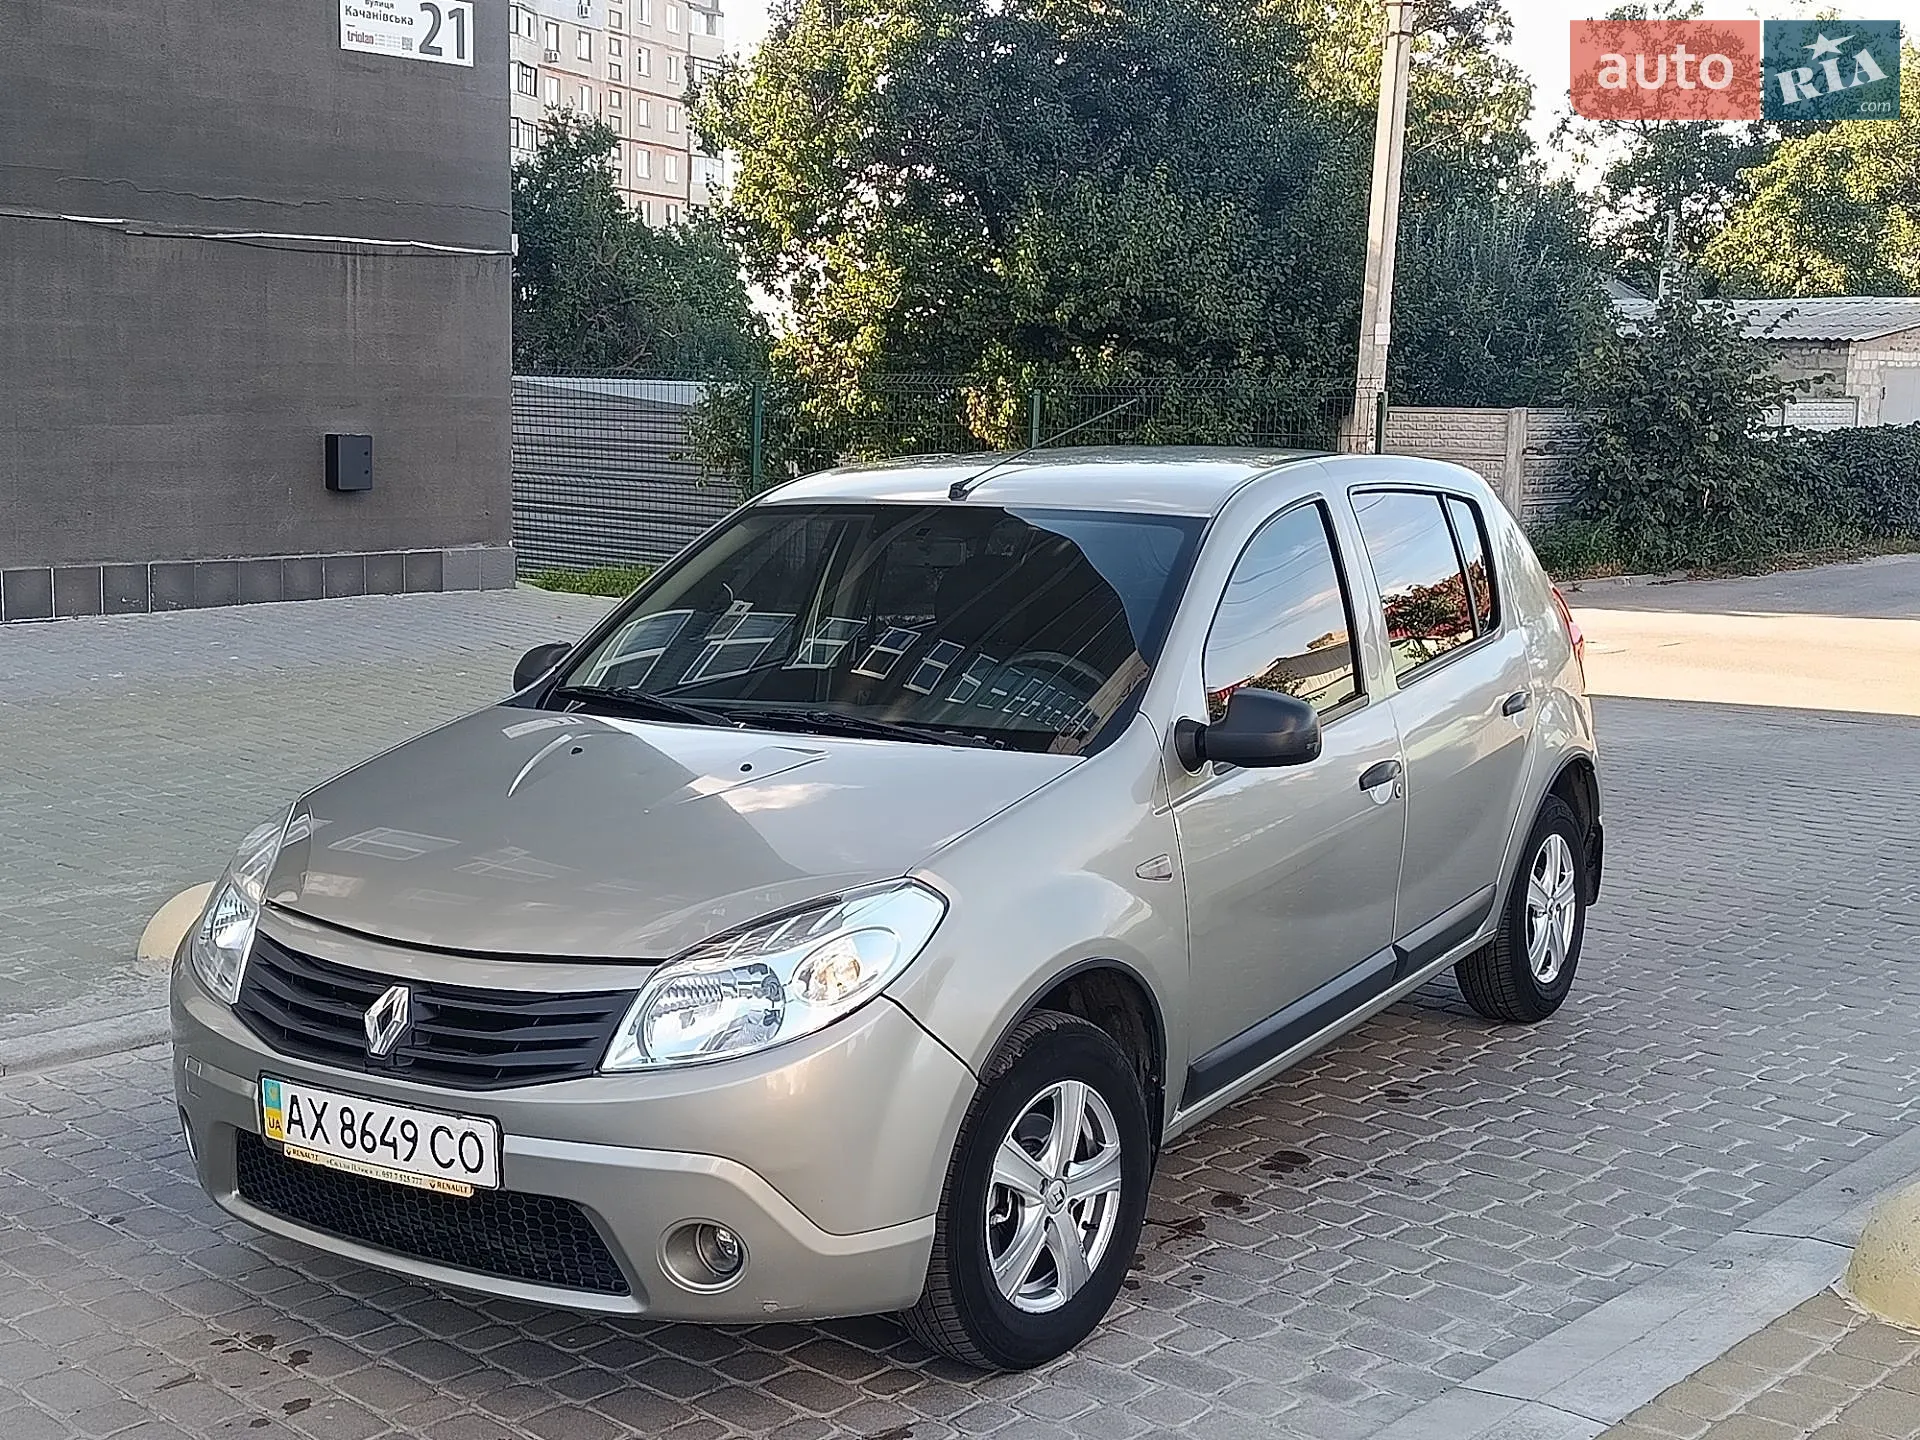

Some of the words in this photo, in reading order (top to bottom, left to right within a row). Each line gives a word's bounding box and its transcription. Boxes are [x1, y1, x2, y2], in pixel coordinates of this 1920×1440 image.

[345, 5, 413, 25] Качанівська
[419, 2, 465, 59] 21
[268, 1117, 282, 1132] UA
[286, 1094, 331, 1144] AX
[340, 1106, 419, 1162] 8649
[430, 1125, 484, 1174] CO
[437, 1181, 469, 1194] RENAULT
